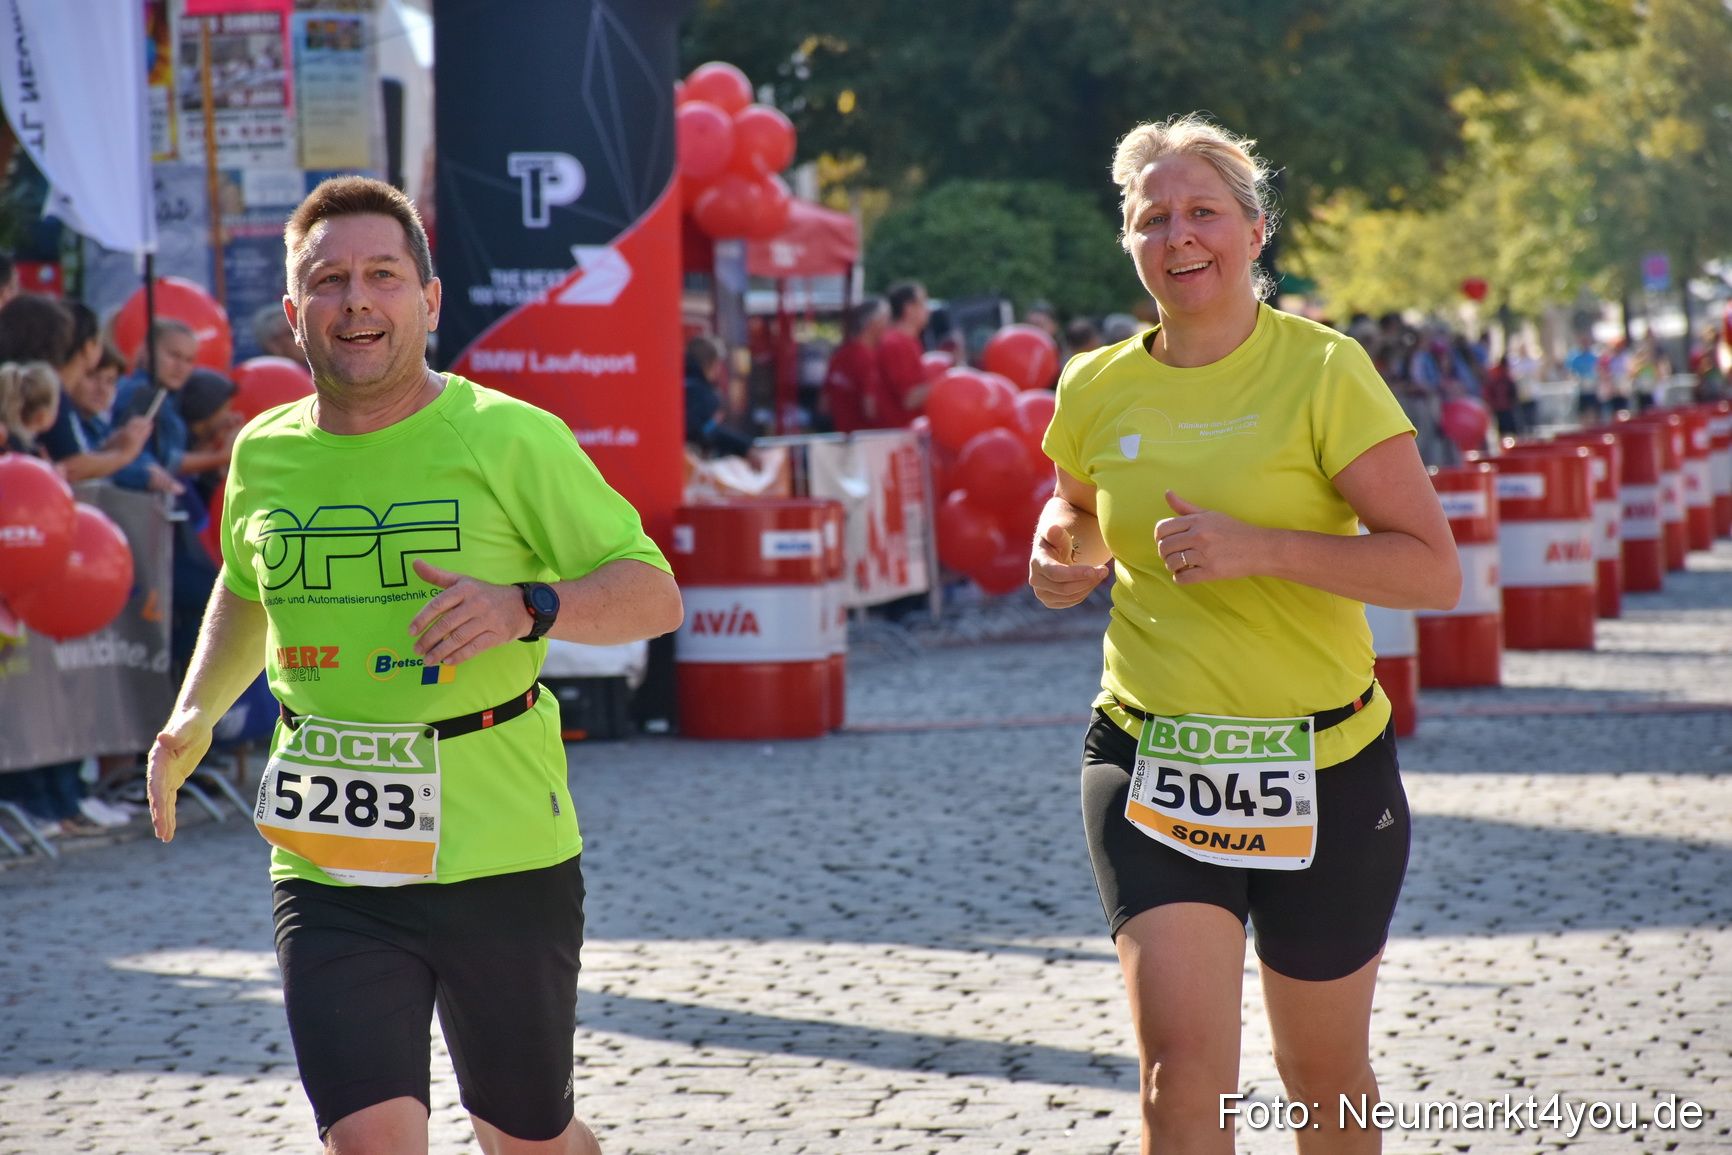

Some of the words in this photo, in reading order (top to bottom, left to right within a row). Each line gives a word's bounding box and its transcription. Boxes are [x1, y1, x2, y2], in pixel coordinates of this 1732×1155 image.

[469, 350, 526, 373] BMW
[528, 350, 637, 377] Laufsport
[1178, 421, 1209, 430] Kliniken
[1199, 426, 1234, 437] Neumarkt
[287, 594, 305, 605] und
[306, 590, 427, 606] Automatisierungstechnik
[1148, 715, 1298, 759] BOCK
[275, 770, 416, 831] 5283
[1151, 766, 1293, 818] 5045
[1171, 825, 1266, 852] SONJA
